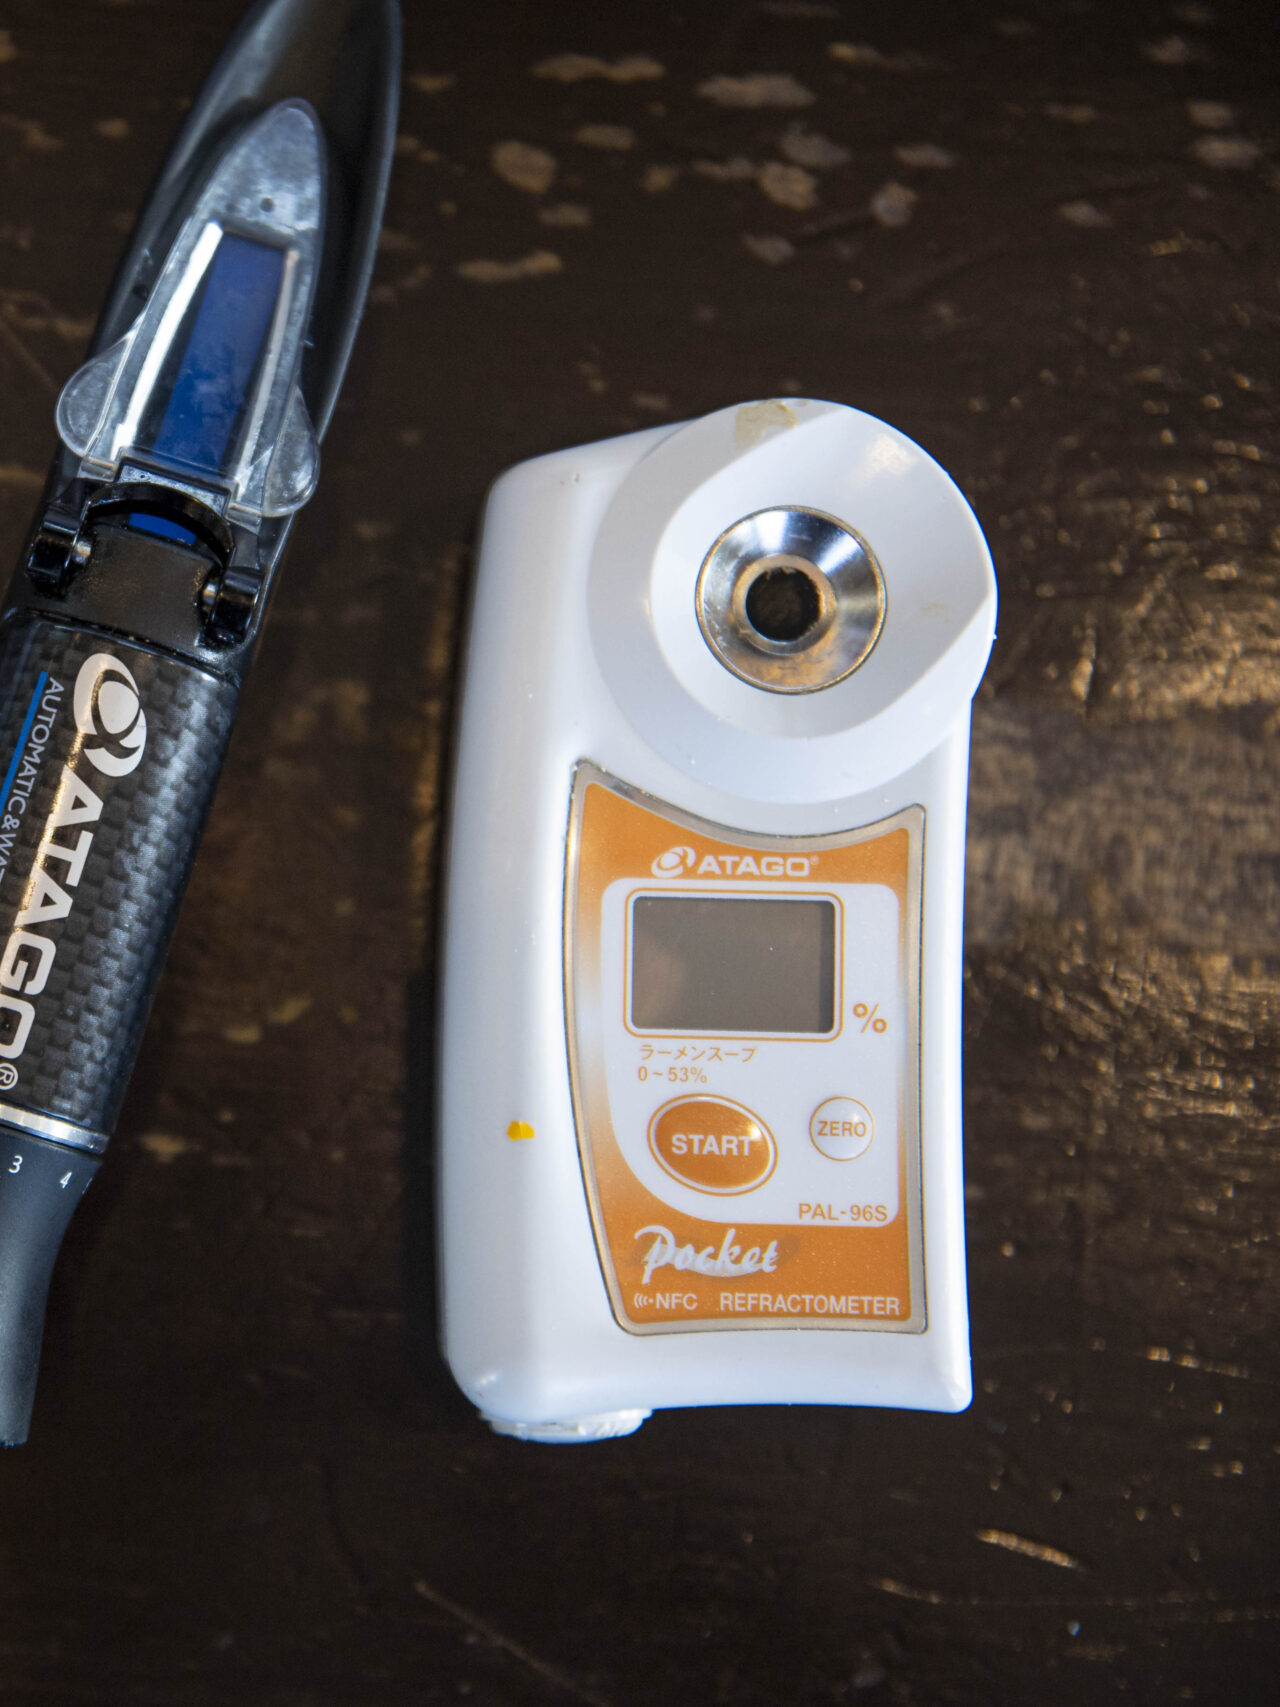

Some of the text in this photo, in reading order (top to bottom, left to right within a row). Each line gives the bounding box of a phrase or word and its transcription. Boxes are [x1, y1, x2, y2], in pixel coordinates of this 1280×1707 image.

[639, 1045, 757, 1063] ラーメンスープ
[817, 1120, 868, 1138] ZERO
[671, 1133, 753, 1156] START
[8, 1155, 23, 1174] 3
[59, 1171, 73, 1189] 4
[798, 1203, 889, 1222] PAL-96S
[656, 1293, 900, 1316] NFC REFRACTOMETER
